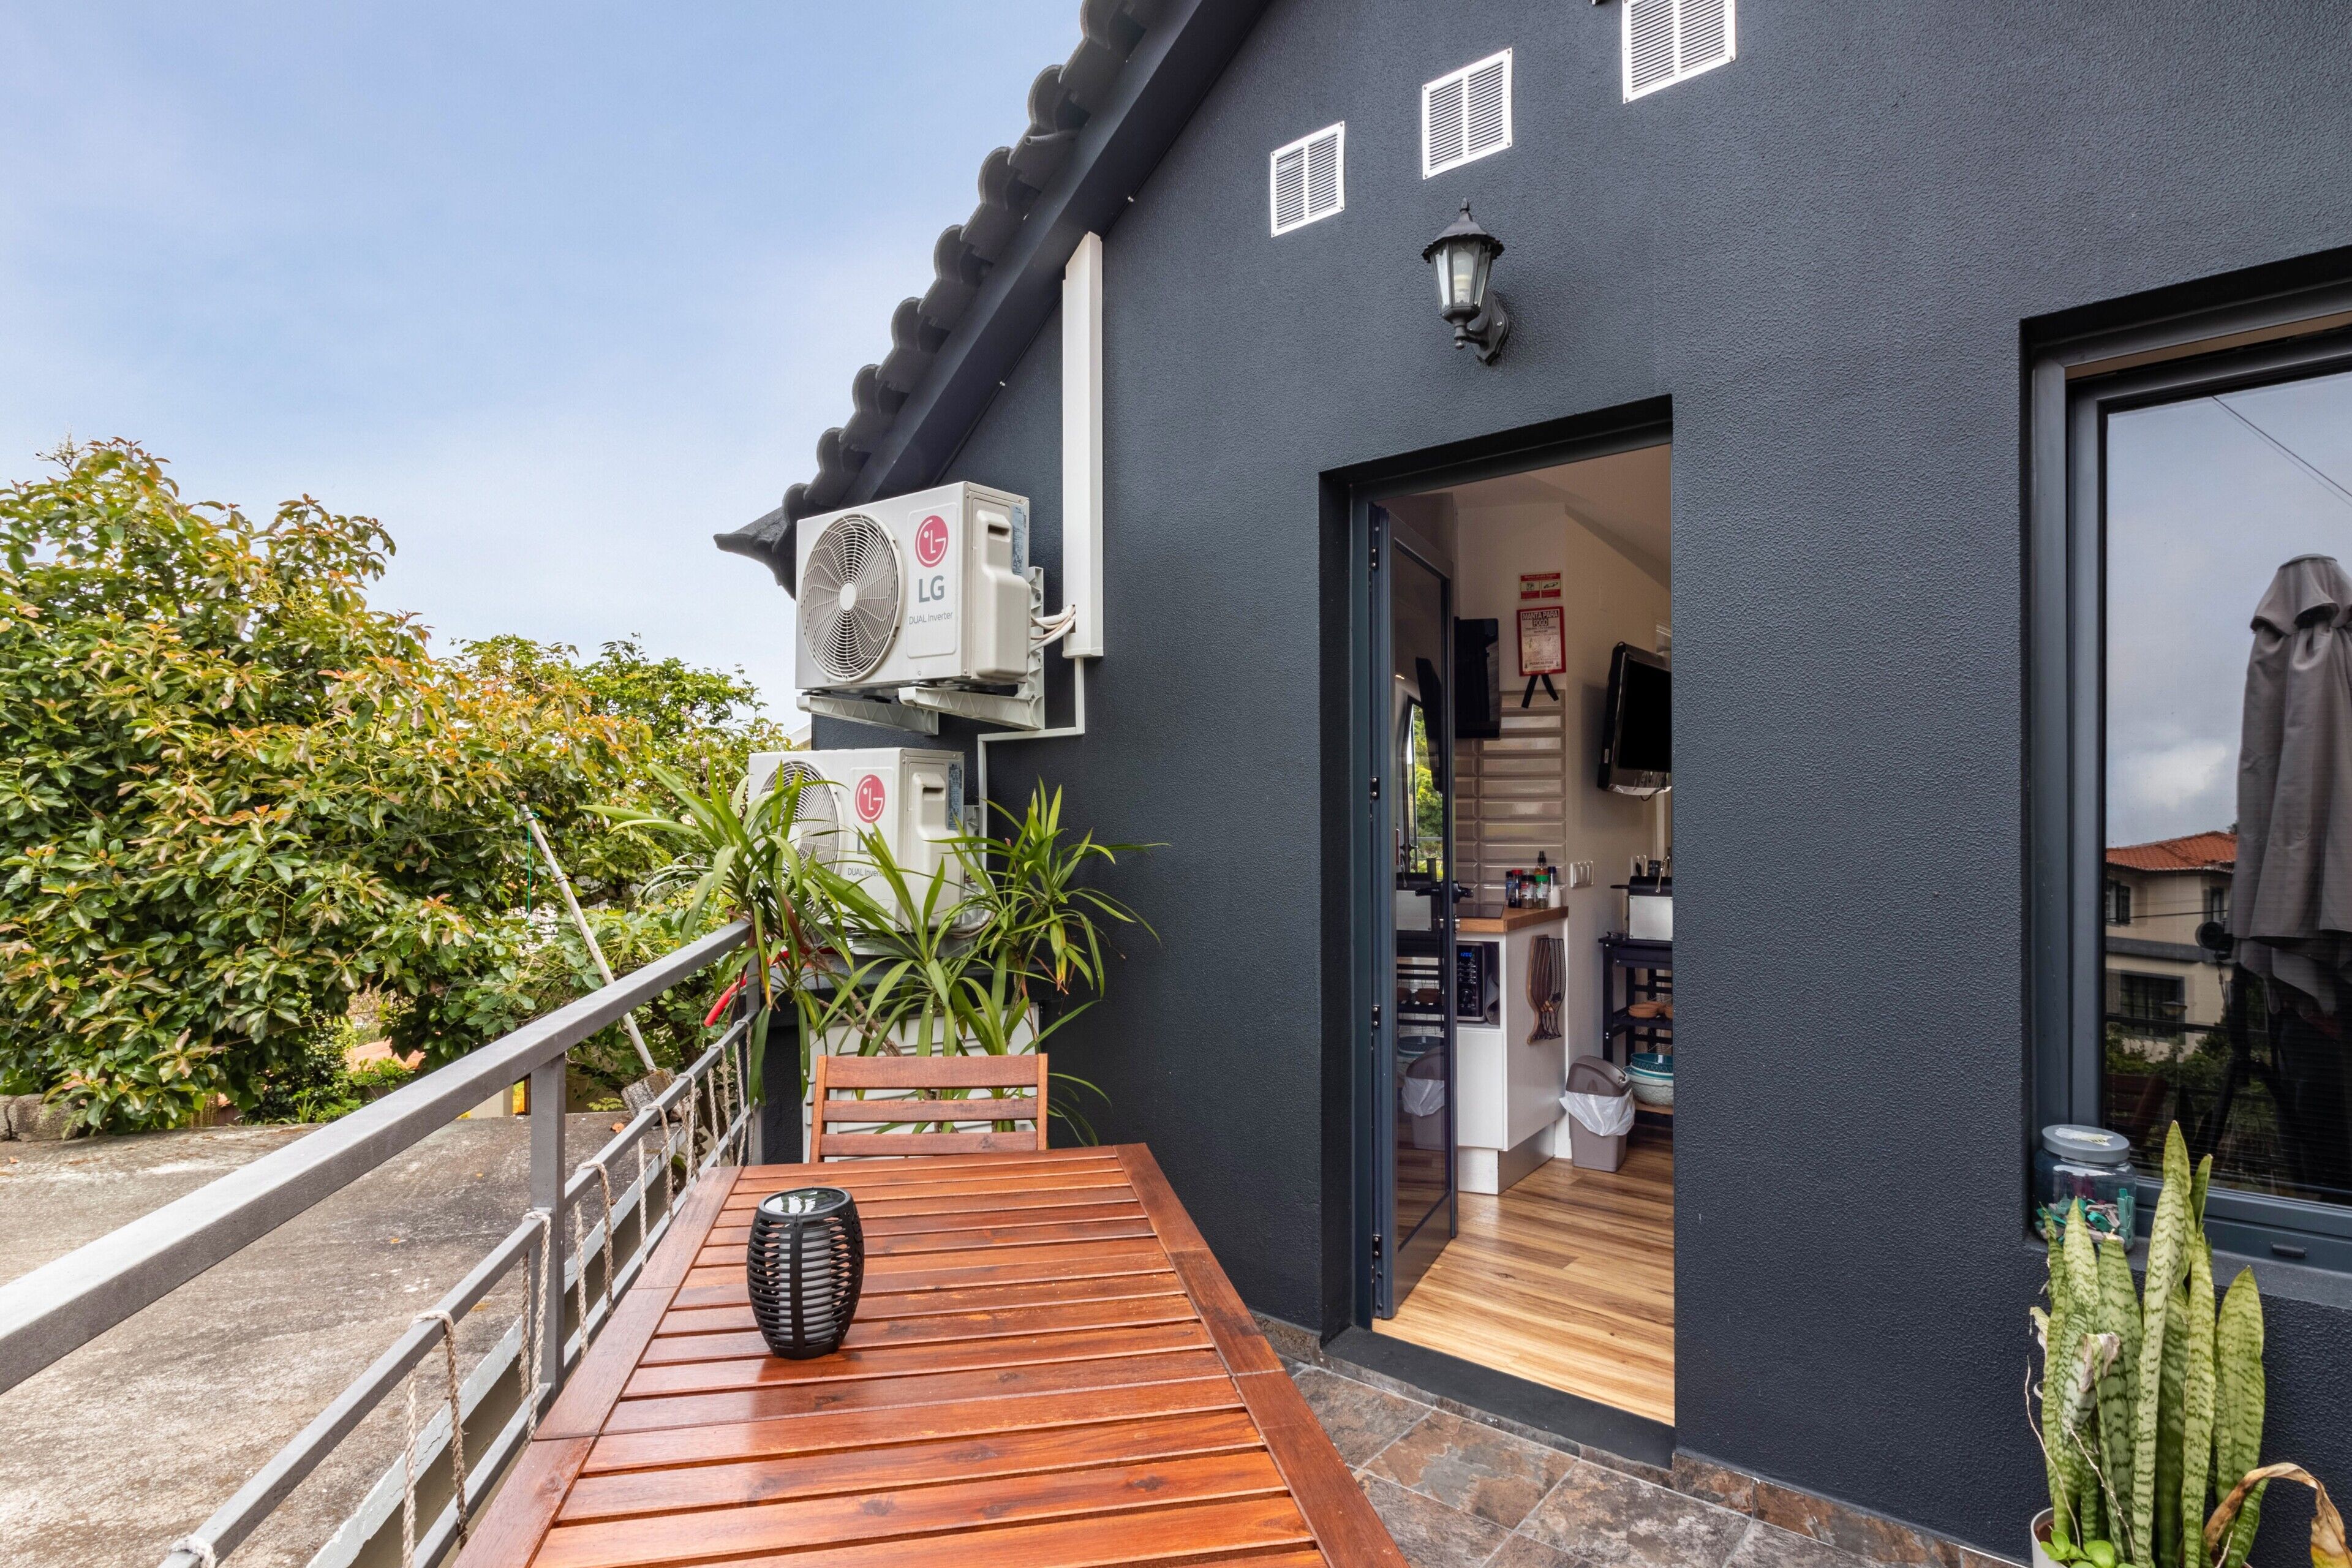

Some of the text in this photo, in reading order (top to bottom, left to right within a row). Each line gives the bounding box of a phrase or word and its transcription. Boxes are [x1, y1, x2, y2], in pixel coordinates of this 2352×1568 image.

[919, 575, 944, 603] LG
[909, 611, 952, 625] DUAL Inverter
[1523, 612, 1542, 620] MANTA
[848, 867, 863, 876] DUAL
